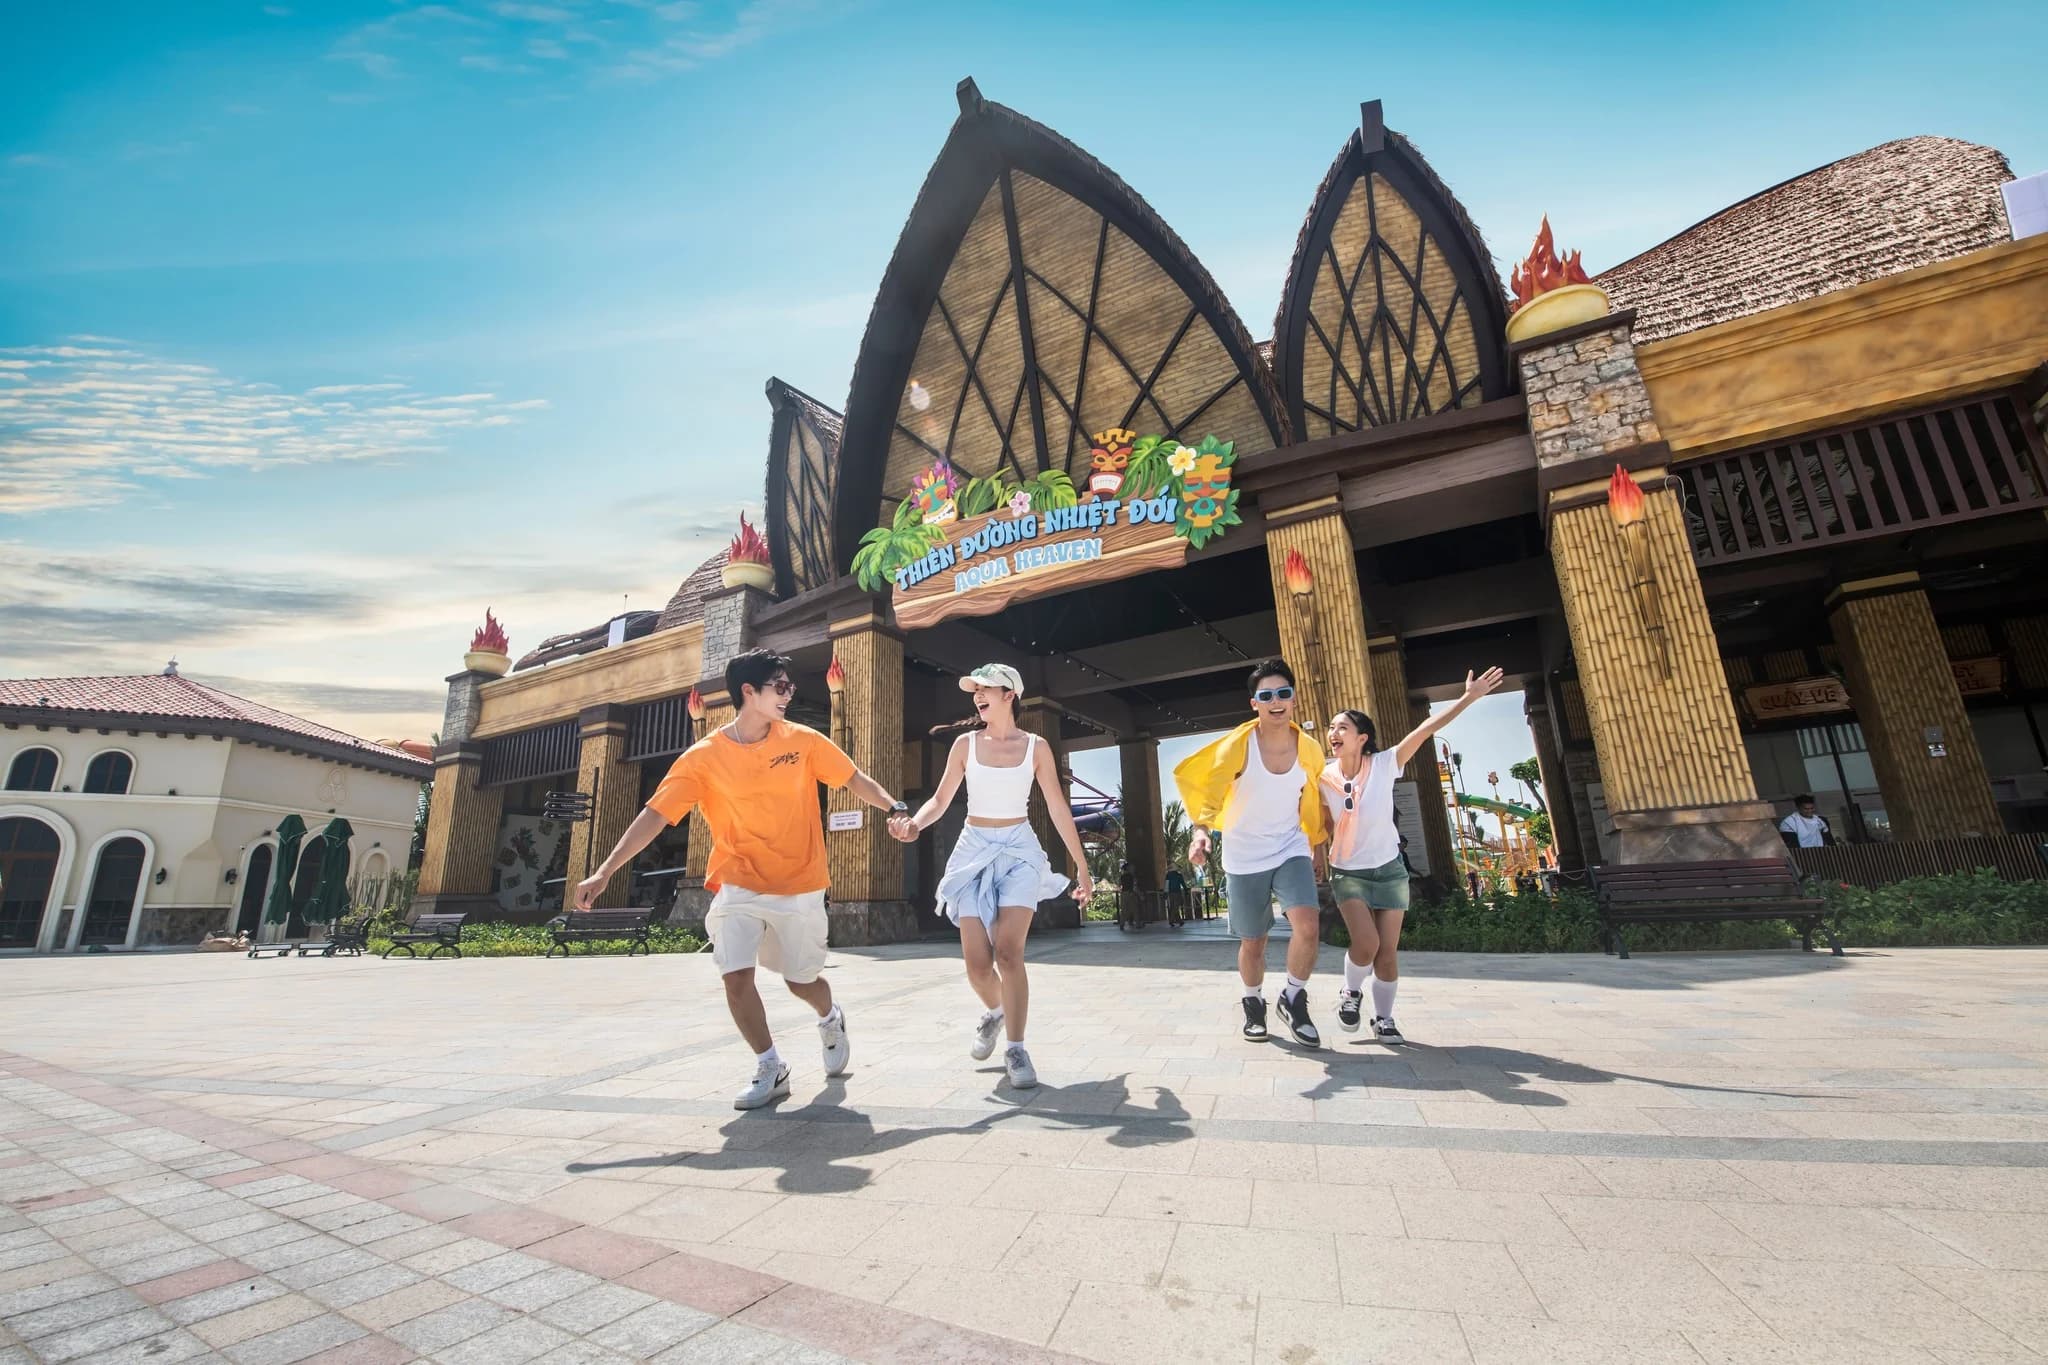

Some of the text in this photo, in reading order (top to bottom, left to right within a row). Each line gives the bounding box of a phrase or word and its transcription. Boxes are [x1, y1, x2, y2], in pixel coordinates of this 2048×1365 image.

[895, 485, 1178, 591] THIÊN ĐƯỜNG NHIỆT ĐỚI
[954, 537, 1103, 593] AQUA HEAVEN
